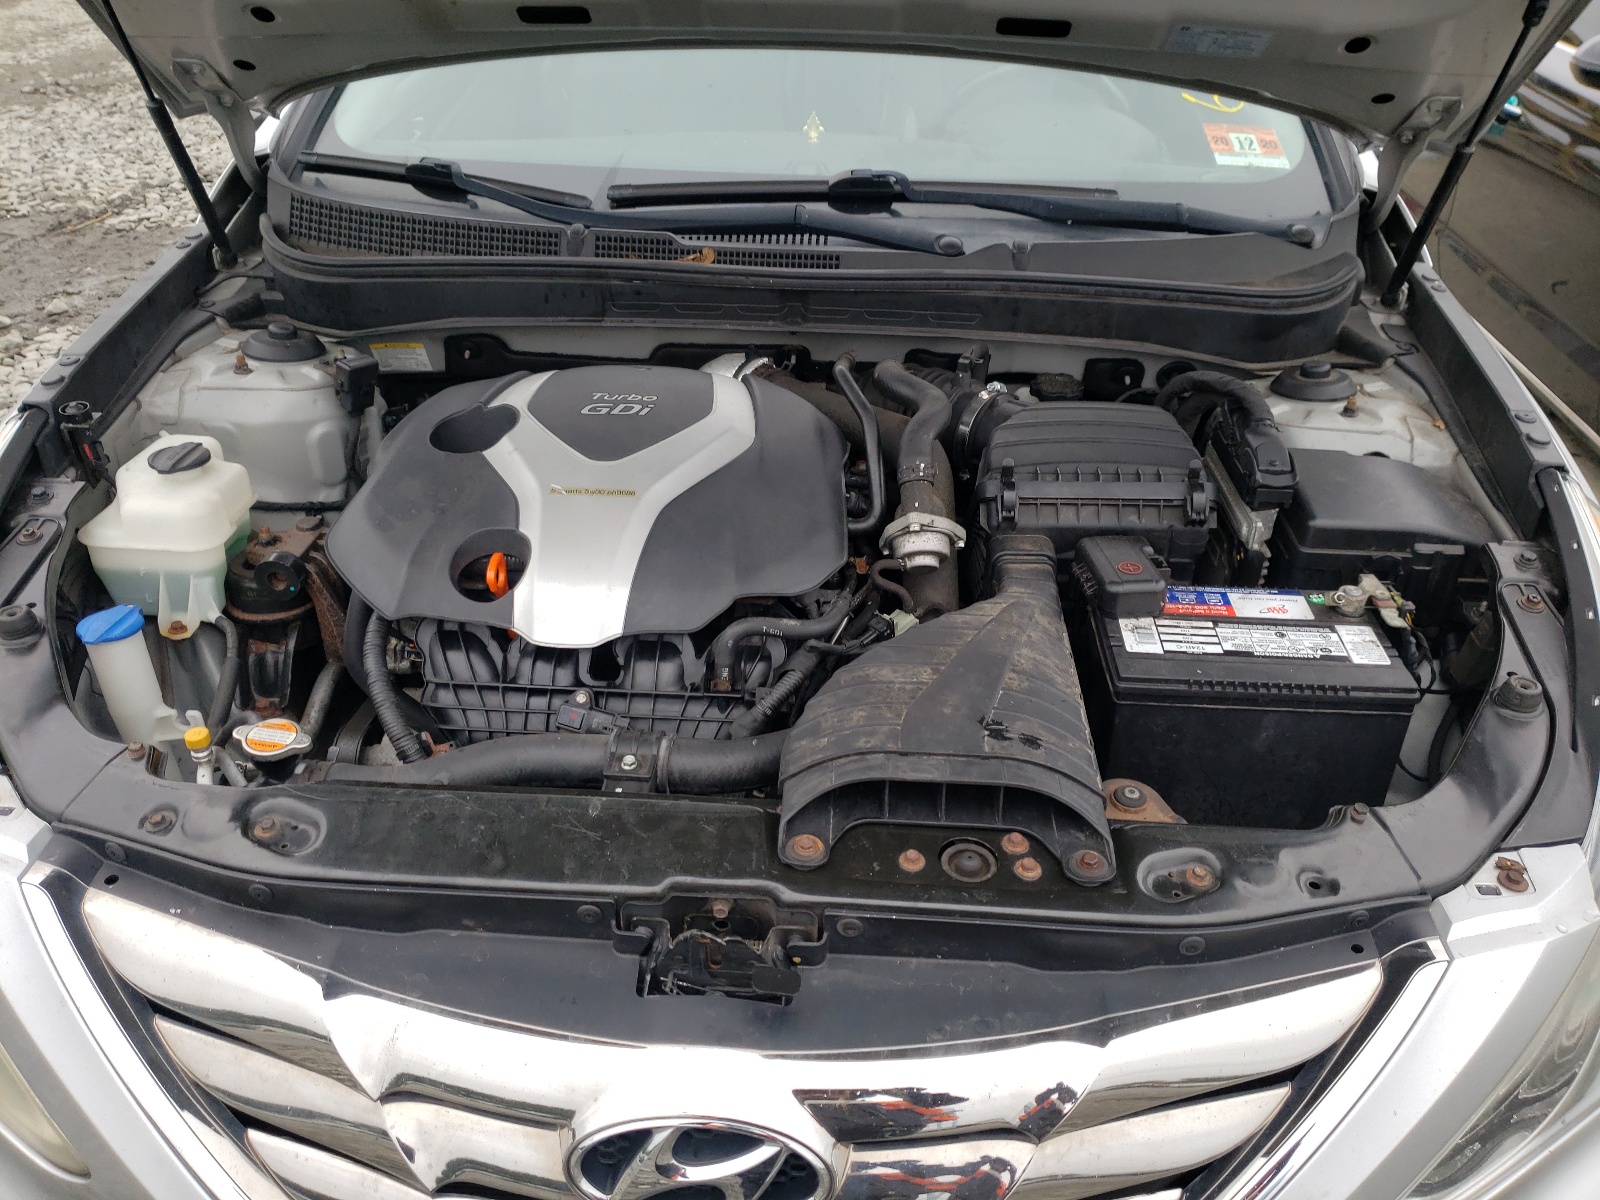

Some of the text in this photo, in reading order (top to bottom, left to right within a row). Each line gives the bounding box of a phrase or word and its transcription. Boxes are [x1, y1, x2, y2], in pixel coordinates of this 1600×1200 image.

[1235, 136, 1257, 152] 12
[1260, 139, 1278, 150] 20
[592, 392, 658, 402] Turbo
[580, 403, 655, 416] GDi
